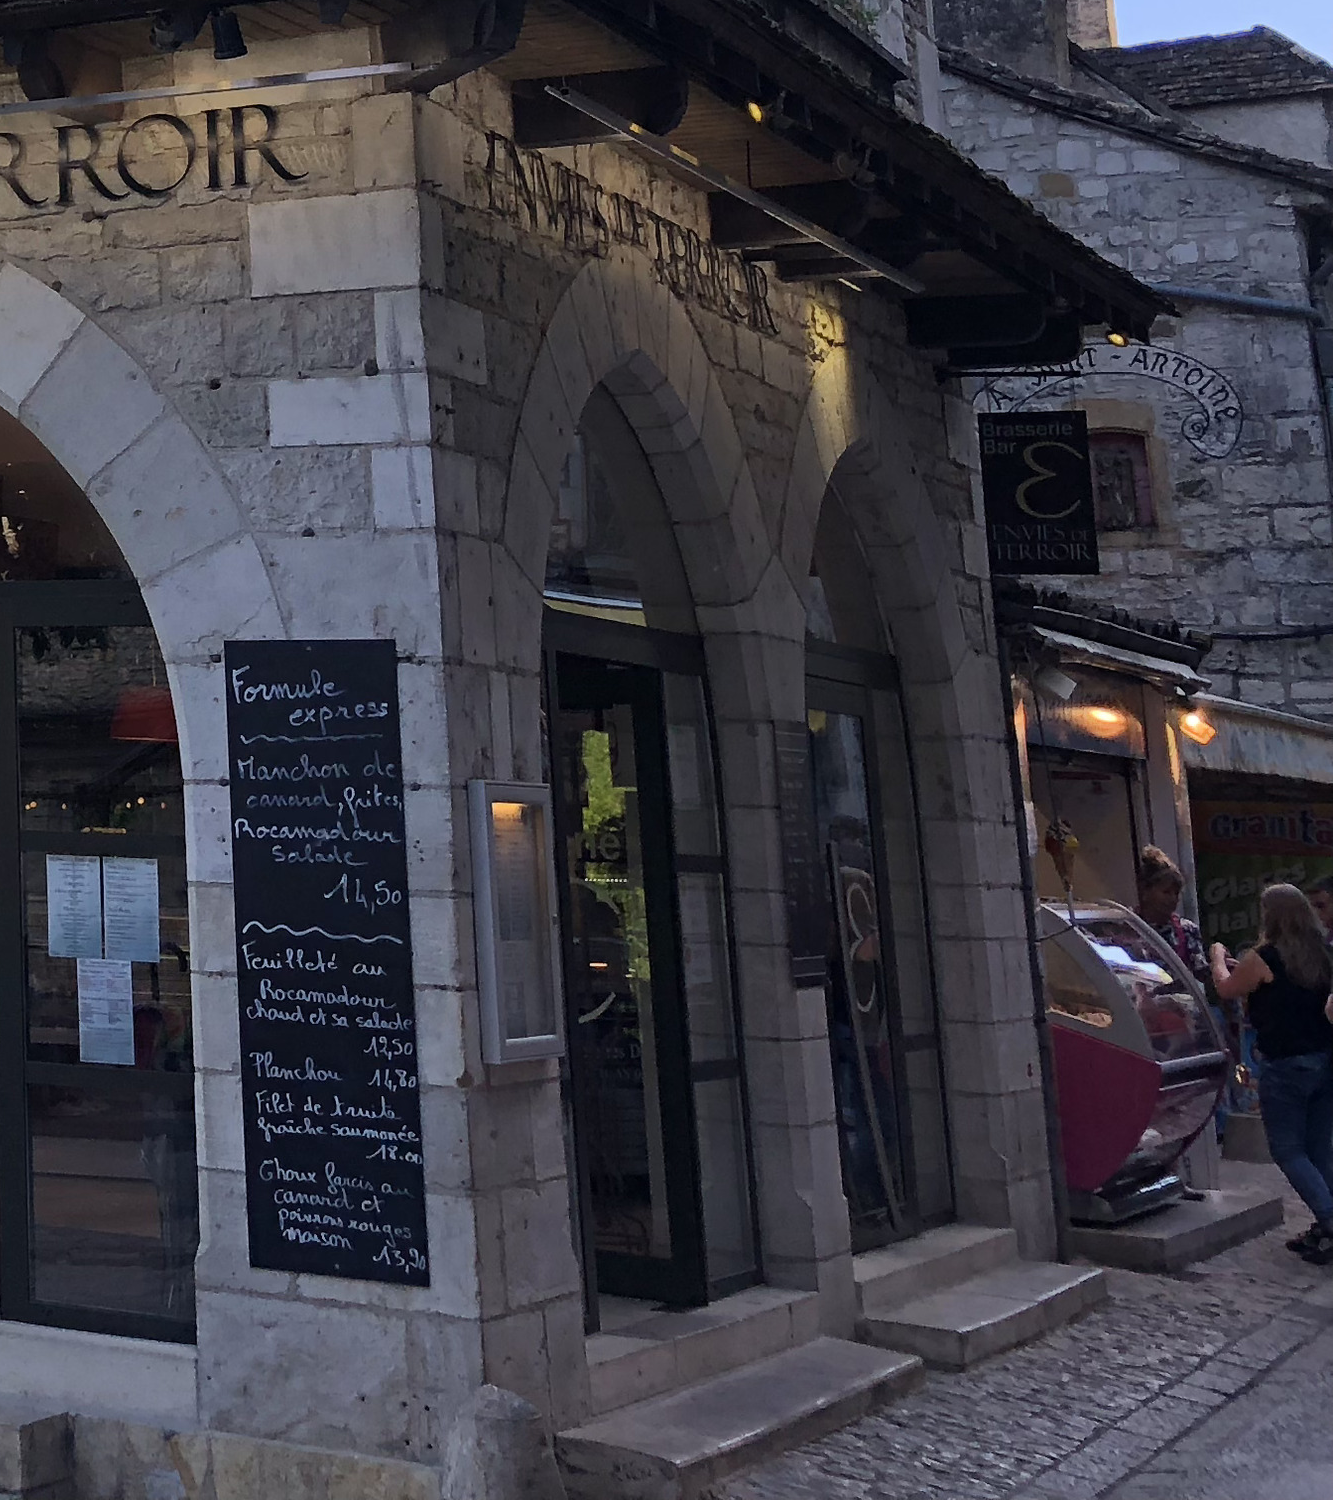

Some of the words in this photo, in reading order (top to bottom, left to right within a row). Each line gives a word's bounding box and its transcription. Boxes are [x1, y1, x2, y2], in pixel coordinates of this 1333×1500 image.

[983, 421, 1073, 437] Brasserie
[984, 439, 1017, 455] Bar
[992, 524, 1067, 542] ENVIES
[996, 542, 1092, 562] TERROIR
[233, 665, 347, 704] Formule
[288, 702, 389, 735] express
[237, 753, 350, 781] Manchon
[363, 750, 397, 778] de
[234, 818, 401, 843] Rocamadour
[323, 873, 402, 915] 14,50
[242, 940, 338, 973] Feuilleté
[352, 962, 387, 976] au
[260, 978, 397, 1009] Rocamadour
[246, 998, 305, 1022] chaud
[309, 1007, 327, 1026] et
[331, 1014, 349, 1028] sa
[355, 1011, 413, 1031] salade
[363, 1036, 413, 1060] 12,50
[367, 1068, 417, 1092] 14,80
[255, 1089, 295, 1115] Filet
[303, 1096, 323, 1116] de
[330, 1095, 402, 1120] truite
[324, 1161, 374, 1195] farcis
[381, 1182, 415, 1198] au
[361, 1195, 383, 1213] et
[278, 1207, 344, 1231] poivrons
[347, 1219, 412, 1248] rouges
